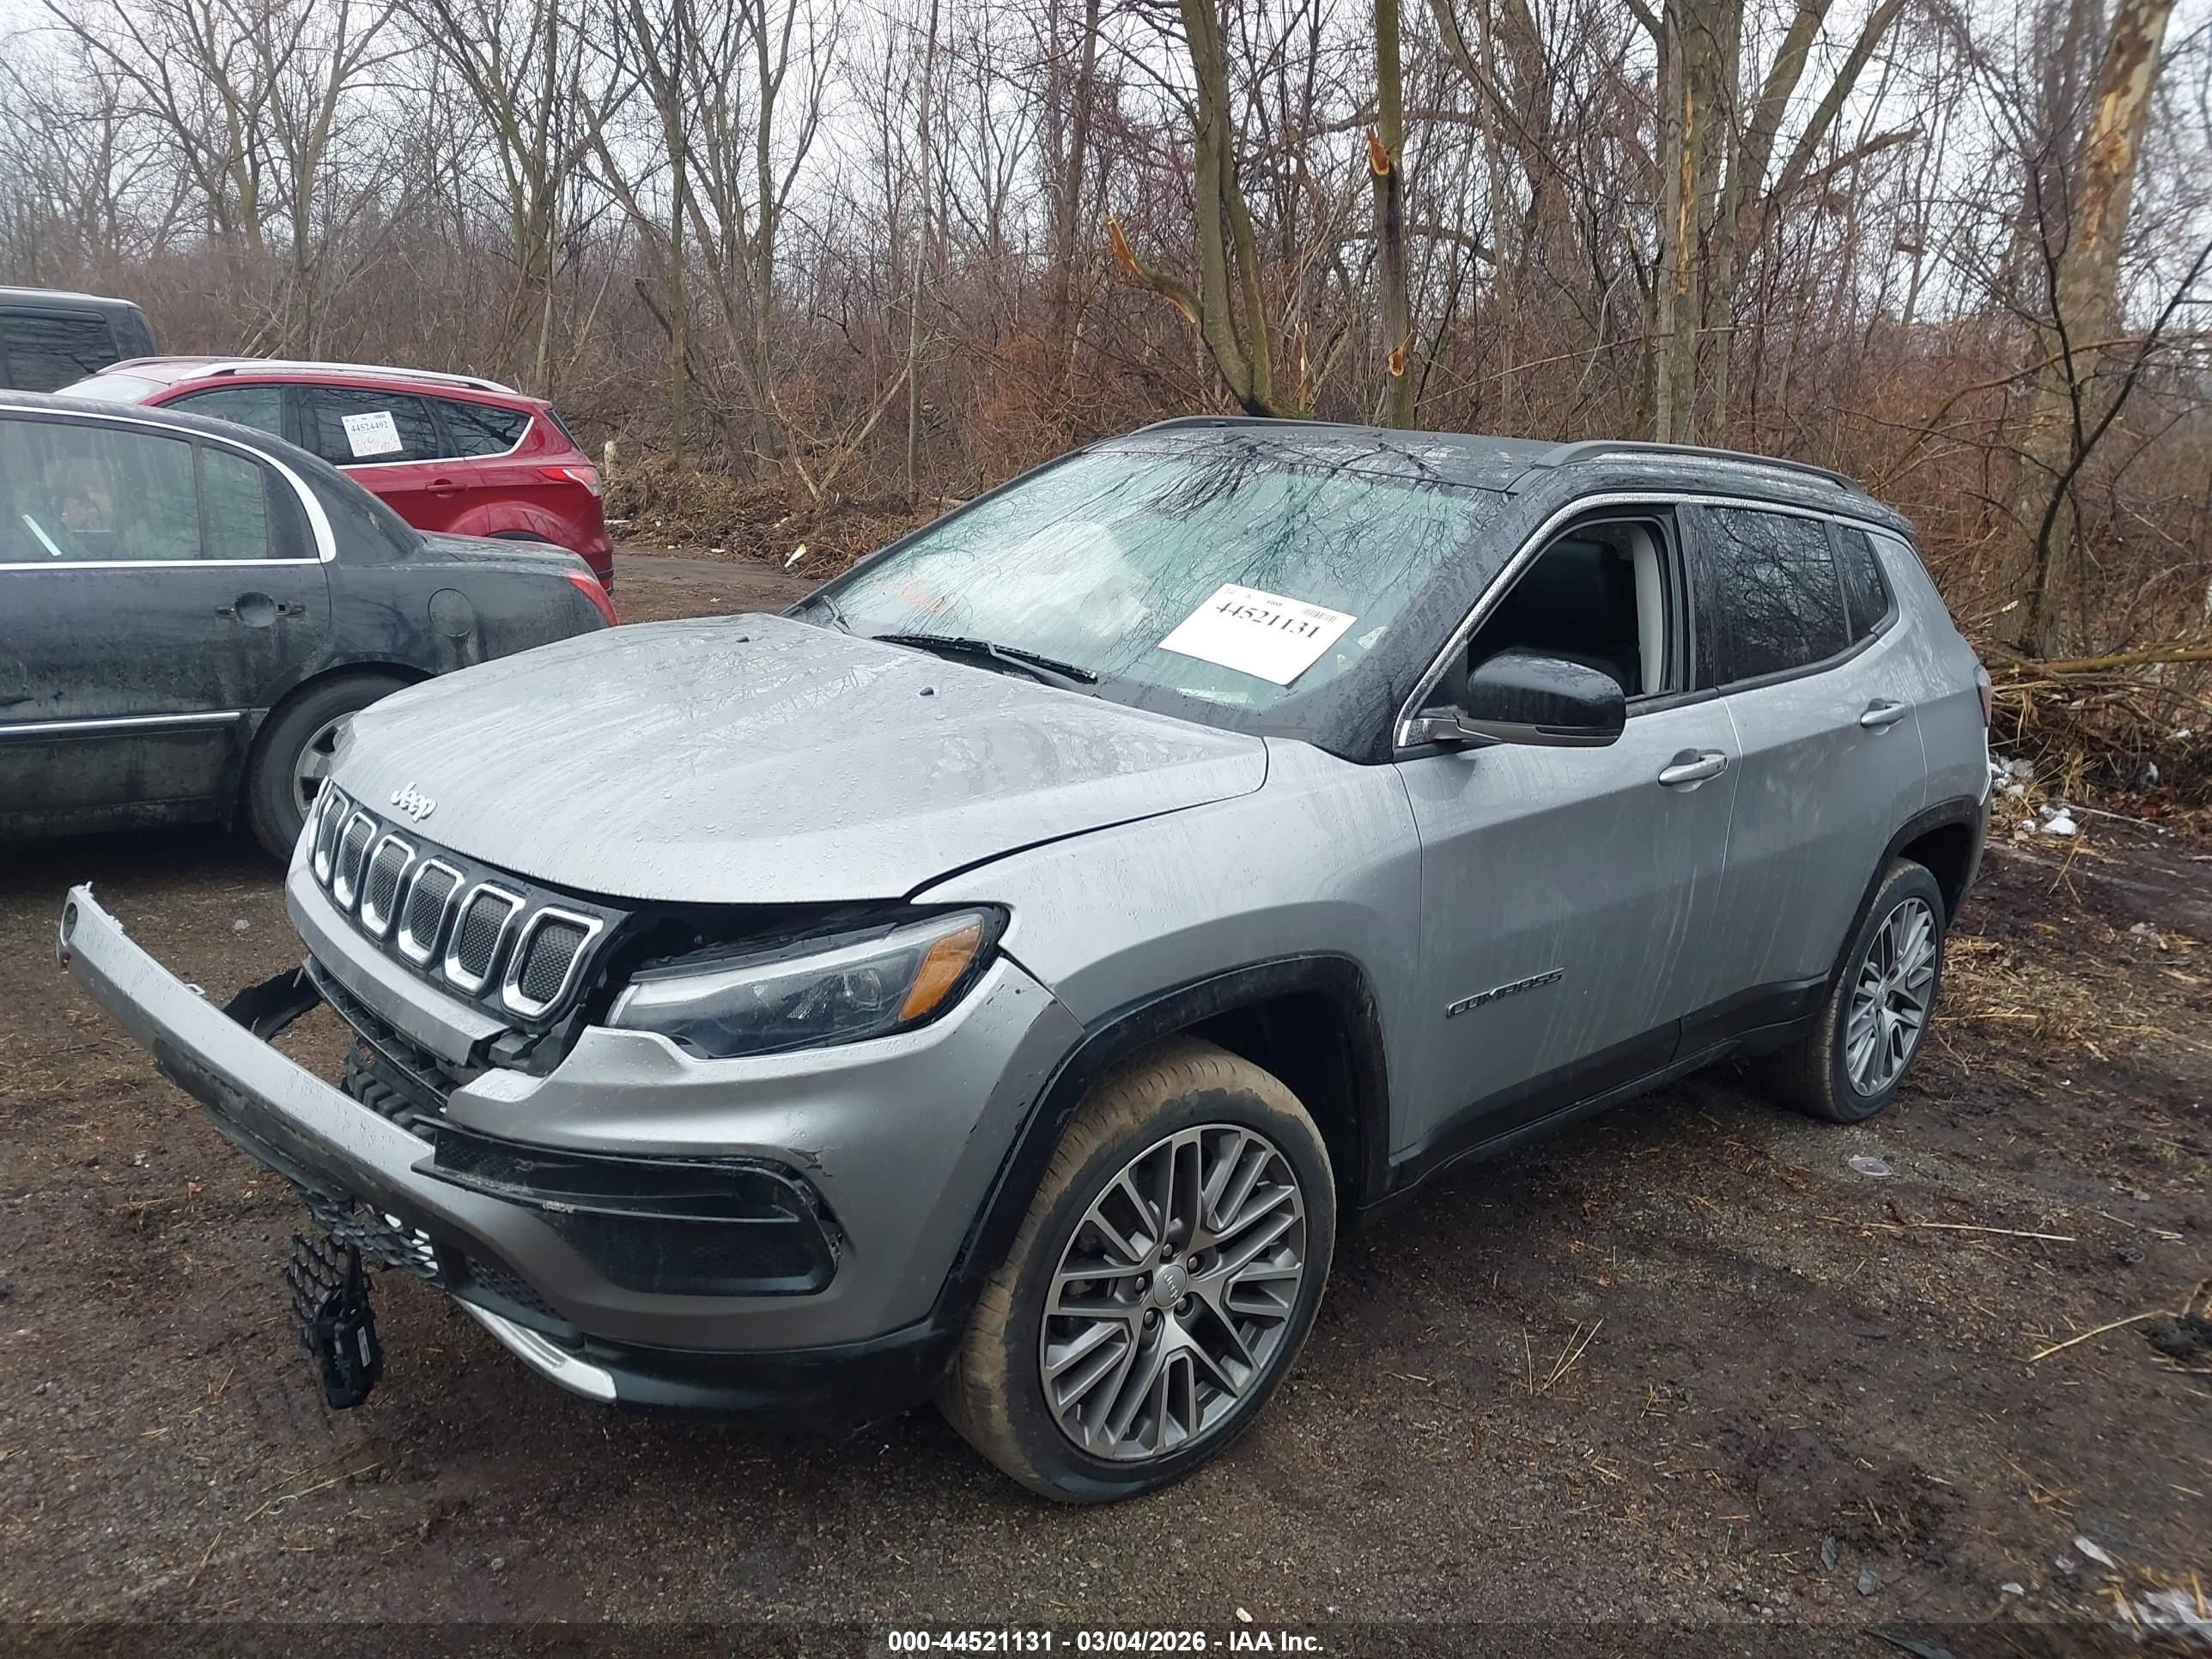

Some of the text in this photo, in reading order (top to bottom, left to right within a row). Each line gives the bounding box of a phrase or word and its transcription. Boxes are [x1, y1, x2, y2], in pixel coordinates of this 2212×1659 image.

[350, 420, 389, 433] 44524492
[1216, 601, 1321, 638] 44521131
[391, 781, 437, 823] Jeep
[1446, 967, 1565, 1018] COMPASS
[1164, 1274, 1179, 1298] Jeep
